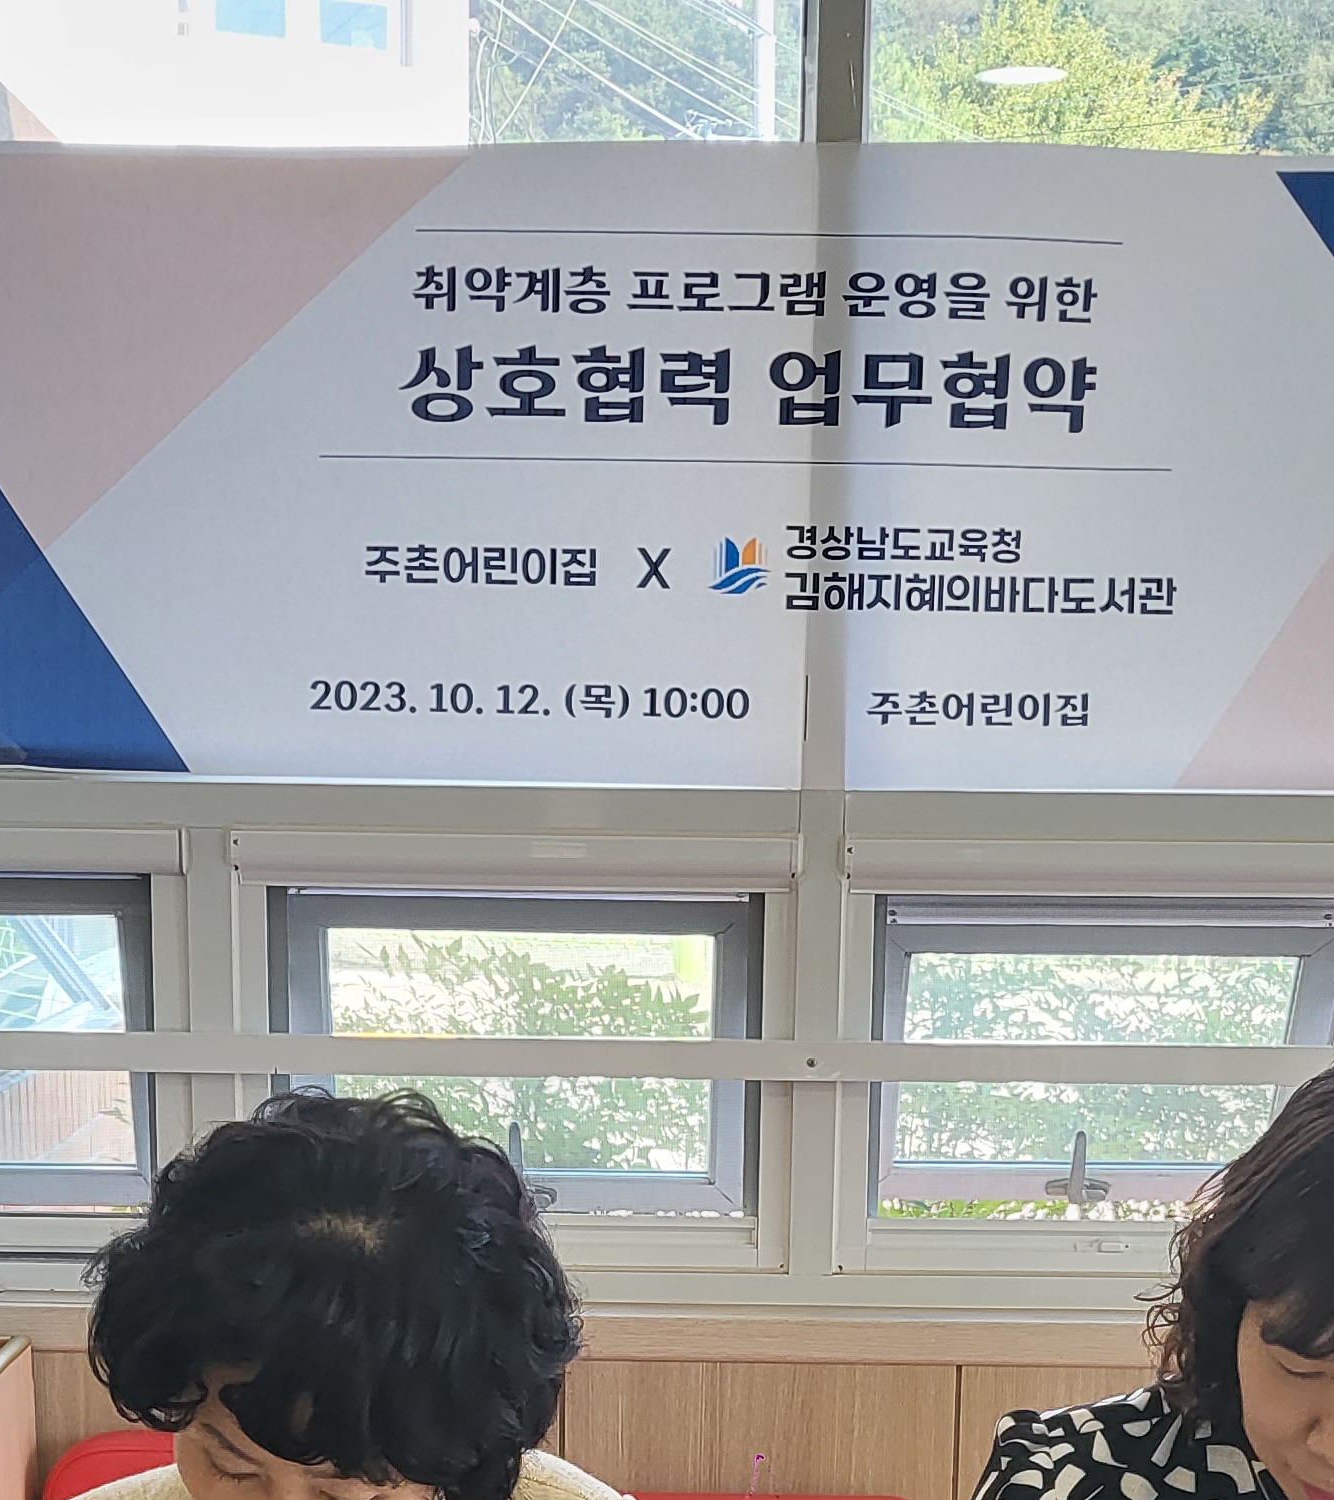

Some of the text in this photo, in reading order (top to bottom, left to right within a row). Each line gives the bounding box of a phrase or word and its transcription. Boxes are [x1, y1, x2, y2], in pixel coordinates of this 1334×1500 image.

[413, 265, 1098, 323] 취약계층 프로그램 운영을 위한
[399, 340, 1097, 433] 상호협력 업무협약
[365, 544, 671, 589] 주촌어린이집 X
[786, 522, 1021, 566] 경상남도교육청
[784, 568, 1177, 618] 김해지혜의바다도서관
[310, 680, 749, 719] 2023. 10. 12. (목) 10:00
[867, 690, 1088, 726] 주촌어린이집
